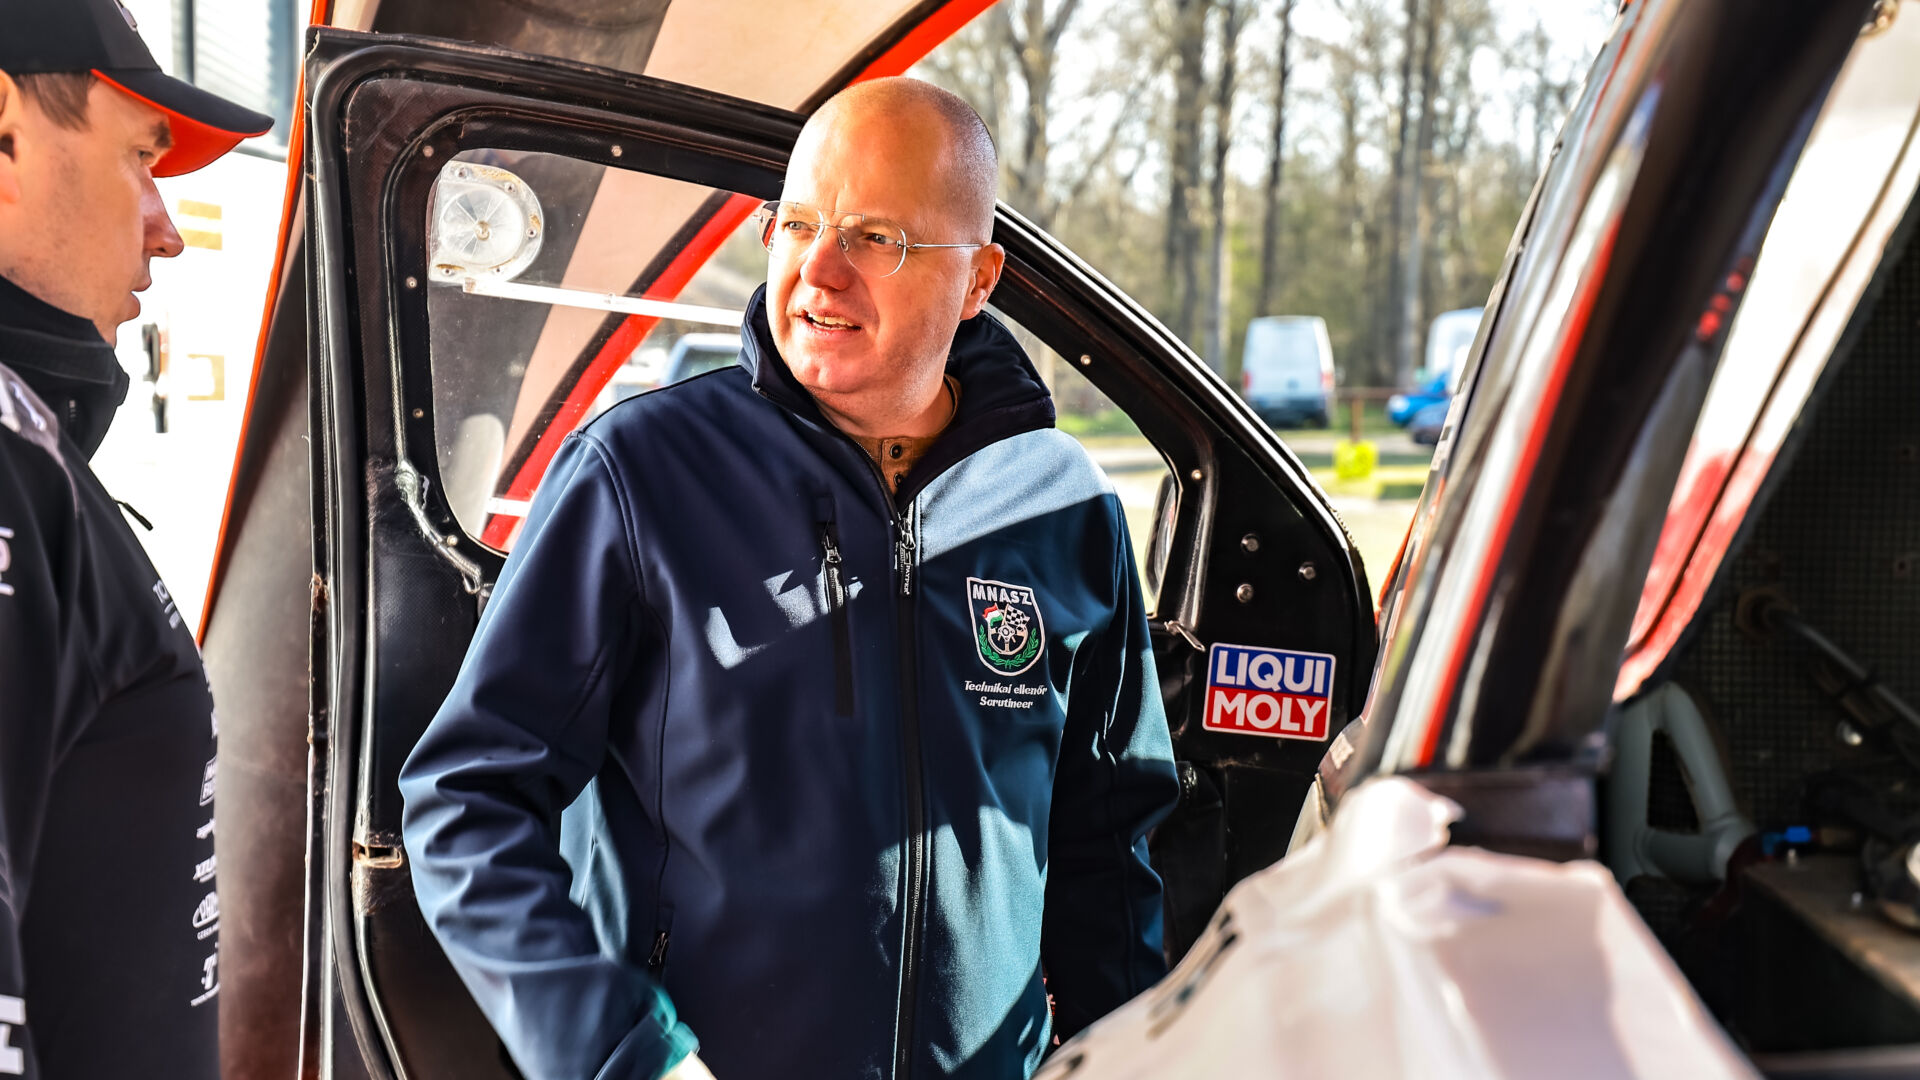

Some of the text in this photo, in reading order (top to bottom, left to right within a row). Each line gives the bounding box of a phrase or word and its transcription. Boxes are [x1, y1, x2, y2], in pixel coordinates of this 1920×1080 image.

[972, 583, 1033, 606] MNASZ
[1216, 650, 1326, 694] LIQUI
[964, 680, 1012, 694] Technikai
[979, 696, 1033, 709] Scrutineer
[1211, 690, 1327, 733] MOLY
